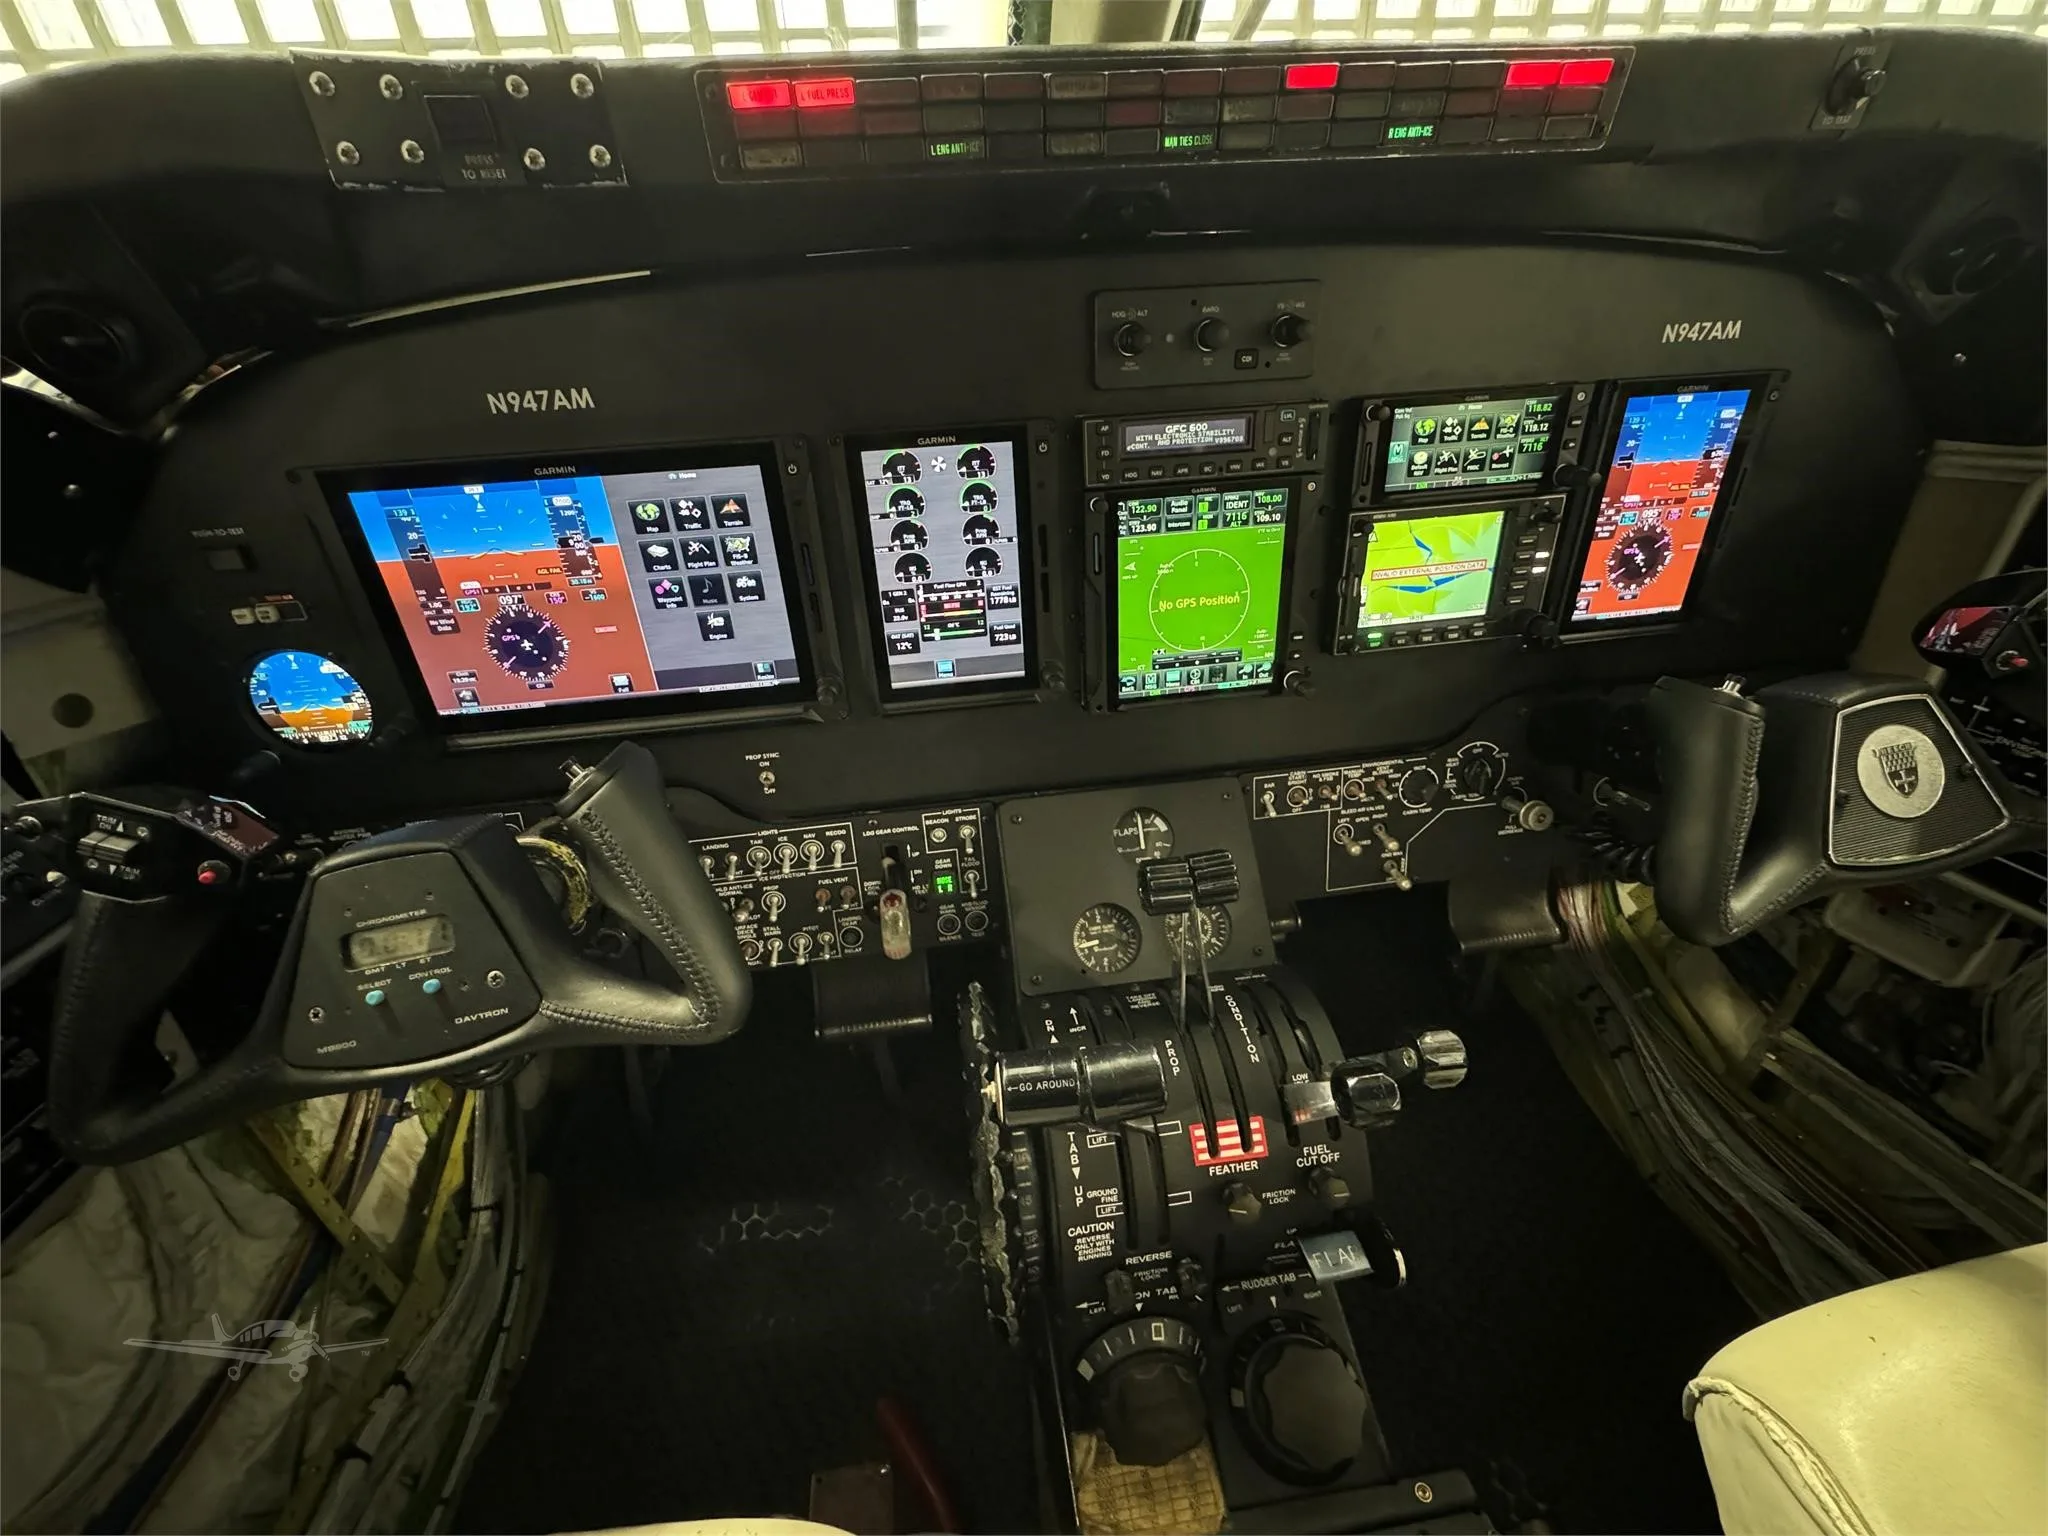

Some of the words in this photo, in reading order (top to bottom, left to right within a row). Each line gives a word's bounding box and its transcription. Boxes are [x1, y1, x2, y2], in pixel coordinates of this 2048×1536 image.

[808, 88, 824, 100] FUEL
[827, 88, 850, 98] PRESS
[1406, 125, 1433, 138] ANTI-ICE
[1179, 136, 1193, 147] TIES
[936, 144, 950, 155] ENG
[1661, 320, 1742, 344] N947AM
[486, 387, 596, 414] N947AM
[1165, 424, 1187, 434] GFC
[1189, 422, 1208, 432] 600
[1524, 422, 1549, 432] 119.12
[1154, 432, 1196, 440] ELECTRONIC
[1198, 428, 1235, 437] STABILITY
[918, 436, 956, 445] GARMIN
[1172, 436, 1214, 446] PROTECTION
[1522, 442, 1544, 452] 7116
[534, 466, 576, 476] GARMIN
[1258, 494, 1282, 504] 108.00
[1132, 504, 1157, 514] 122.90
[1226, 500, 1248, 510] IDENT
[1226, 512, 1248, 522] 7116
[1256, 514, 1280, 522] 109.10
[1132, 523, 1157, 532] 123.90
[406, 532, 418, 540] 20
[1373, 568, 1398, 580] INVALID
[1399, 566, 1432, 576] EXTERNAL
[1465, 560, 1486, 570] DATA
[1159, 599, 1174, 610] No
[1176, 598, 1196, 610] GPS
[1200, 594, 1240, 608] Position
[96, 814, 118, 824] TRIM
[1113, 828, 1140, 838] FLAPS
[702, 842, 730, 850] LANDING
[769, 872, 806, 880] PROTECTION
[356, 908, 427, 928] CHRONOMETER
[364, 966, 386, 976] GMT
[408, 966, 453, 980] CONTROL
[356, 978, 392, 990] SELECT
[454, 1007, 509, 1024] DAVTRON
[1069, 1025, 1088, 1034] INCR
[1224, 994, 1260, 1064] CONDITION
[1164, 1038, 1181, 1076] PROP
[1292, 1072, 1308, 1082] LOW
[1018, 1082, 1033, 1092] GO
[1036, 1078, 1076, 1090] AROUND
[1092, 1136, 1108, 1145] LIFT
[1067, 1131, 1080, 1166] TAB
[1303, 1144, 1331, 1157] FUEL
[1296, 1156, 1319, 1168] CUT
[1320, 1152, 1341, 1164] OFF
[1208, 1160, 1260, 1176] FEATHER
[1074, 1186, 1084, 1208] UP
[1086, 1188, 1118, 1199] GROUND
[1262, 1188, 1297, 1200] FRICTION
[1100, 1195, 1118, 1204] FINE
[1269, 1196, 1290, 1205] LOCK
[1100, 1206, 1117, 1215] LIFT
[1068, 1220, 1116, 1238] CAUTION
[1076, 1233, 1112, 1245] REVERSE
[1074, 1242, 1094, 1252] ONLY
[1096, 1238, 1115, 1248] WITH
[1077, 1251, 1112, 1262] RUNNING
[1078, 1246, 1112, 1257] ENGINES
[1126, 1250, 1173, 1266] REVERSE
[1133, 1267, 1169, 1278] FRICTION
[1240, 1274, 1279, 1290] RUDDER
[1278, 1272, 1297, 1284] TAB
